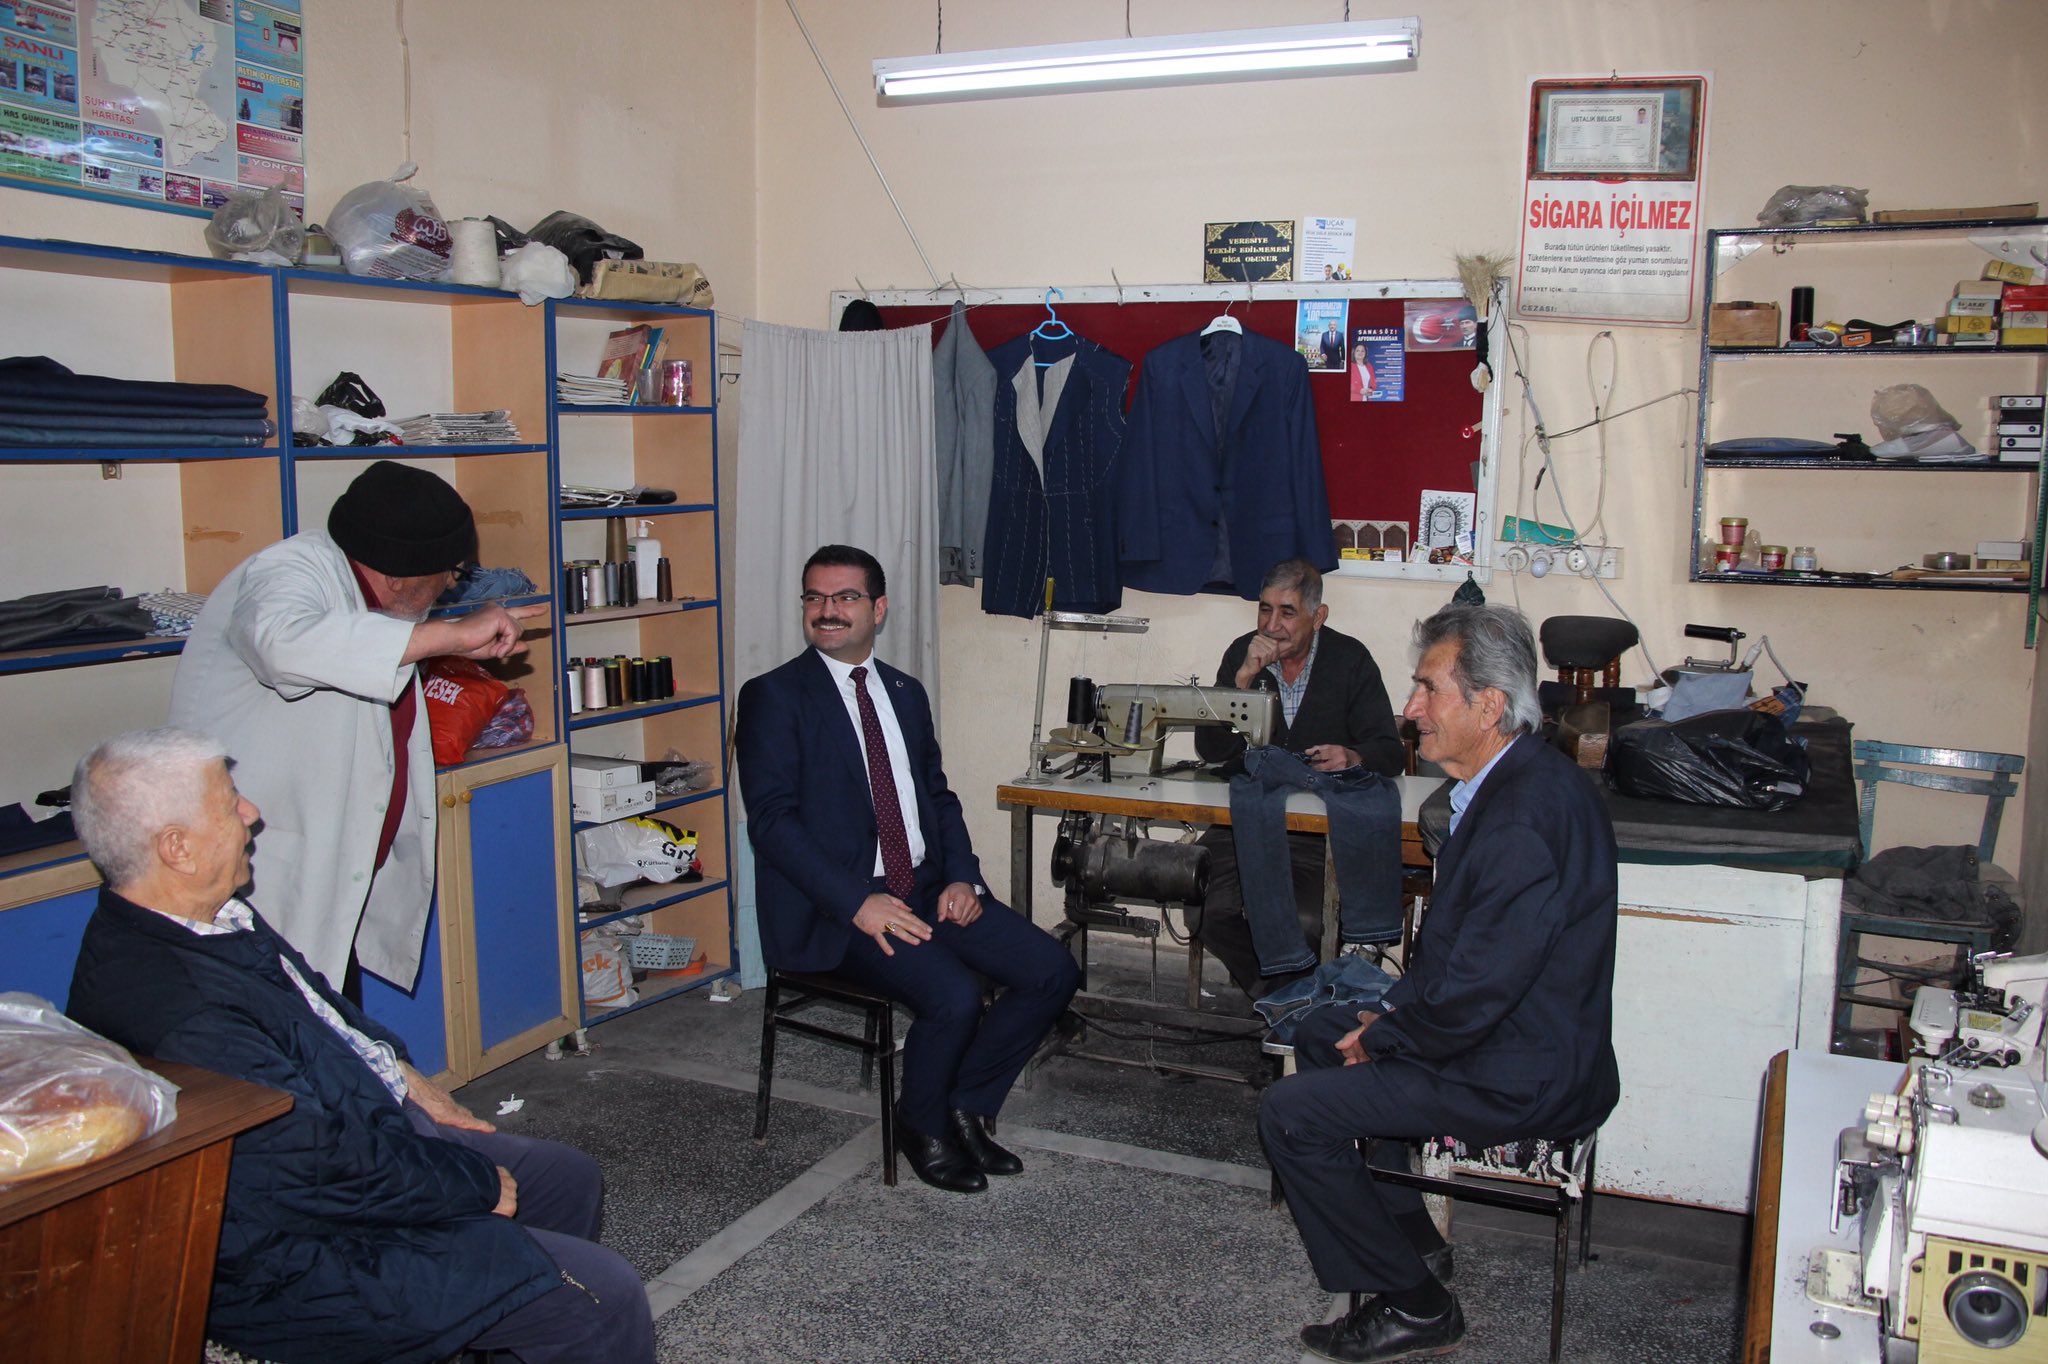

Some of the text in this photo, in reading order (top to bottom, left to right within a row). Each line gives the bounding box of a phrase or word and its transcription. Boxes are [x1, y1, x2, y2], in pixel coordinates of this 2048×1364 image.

[238, 79, 262, 89] LASSA
[1571, 114, 1621, 123] USTALIK BELGESİ
[97, 129, 151, 145] BEREKET
[252, 159, 298, 173] YONCA
[1530, 193, 1691, 238] SİGARA İÇİLMEZ
[413, 217, 446, 241] Mis
[1544, 243, 1566, 251] Burada
[1567, 243, 1583, 251] tütün
[1610, 244, 1644, 252] tüketilmesi
[1528, 254, 1563, 262] Tüketenlere
[1573, 255, 1614, 263] tüketilmesine
[1615, 256, 1627, 265] göz
[1650, 257, 1688, 265] sorumlulara
[1558, 266, 1579, 274] Kanun
[1622, 268, 1636, 276] para
